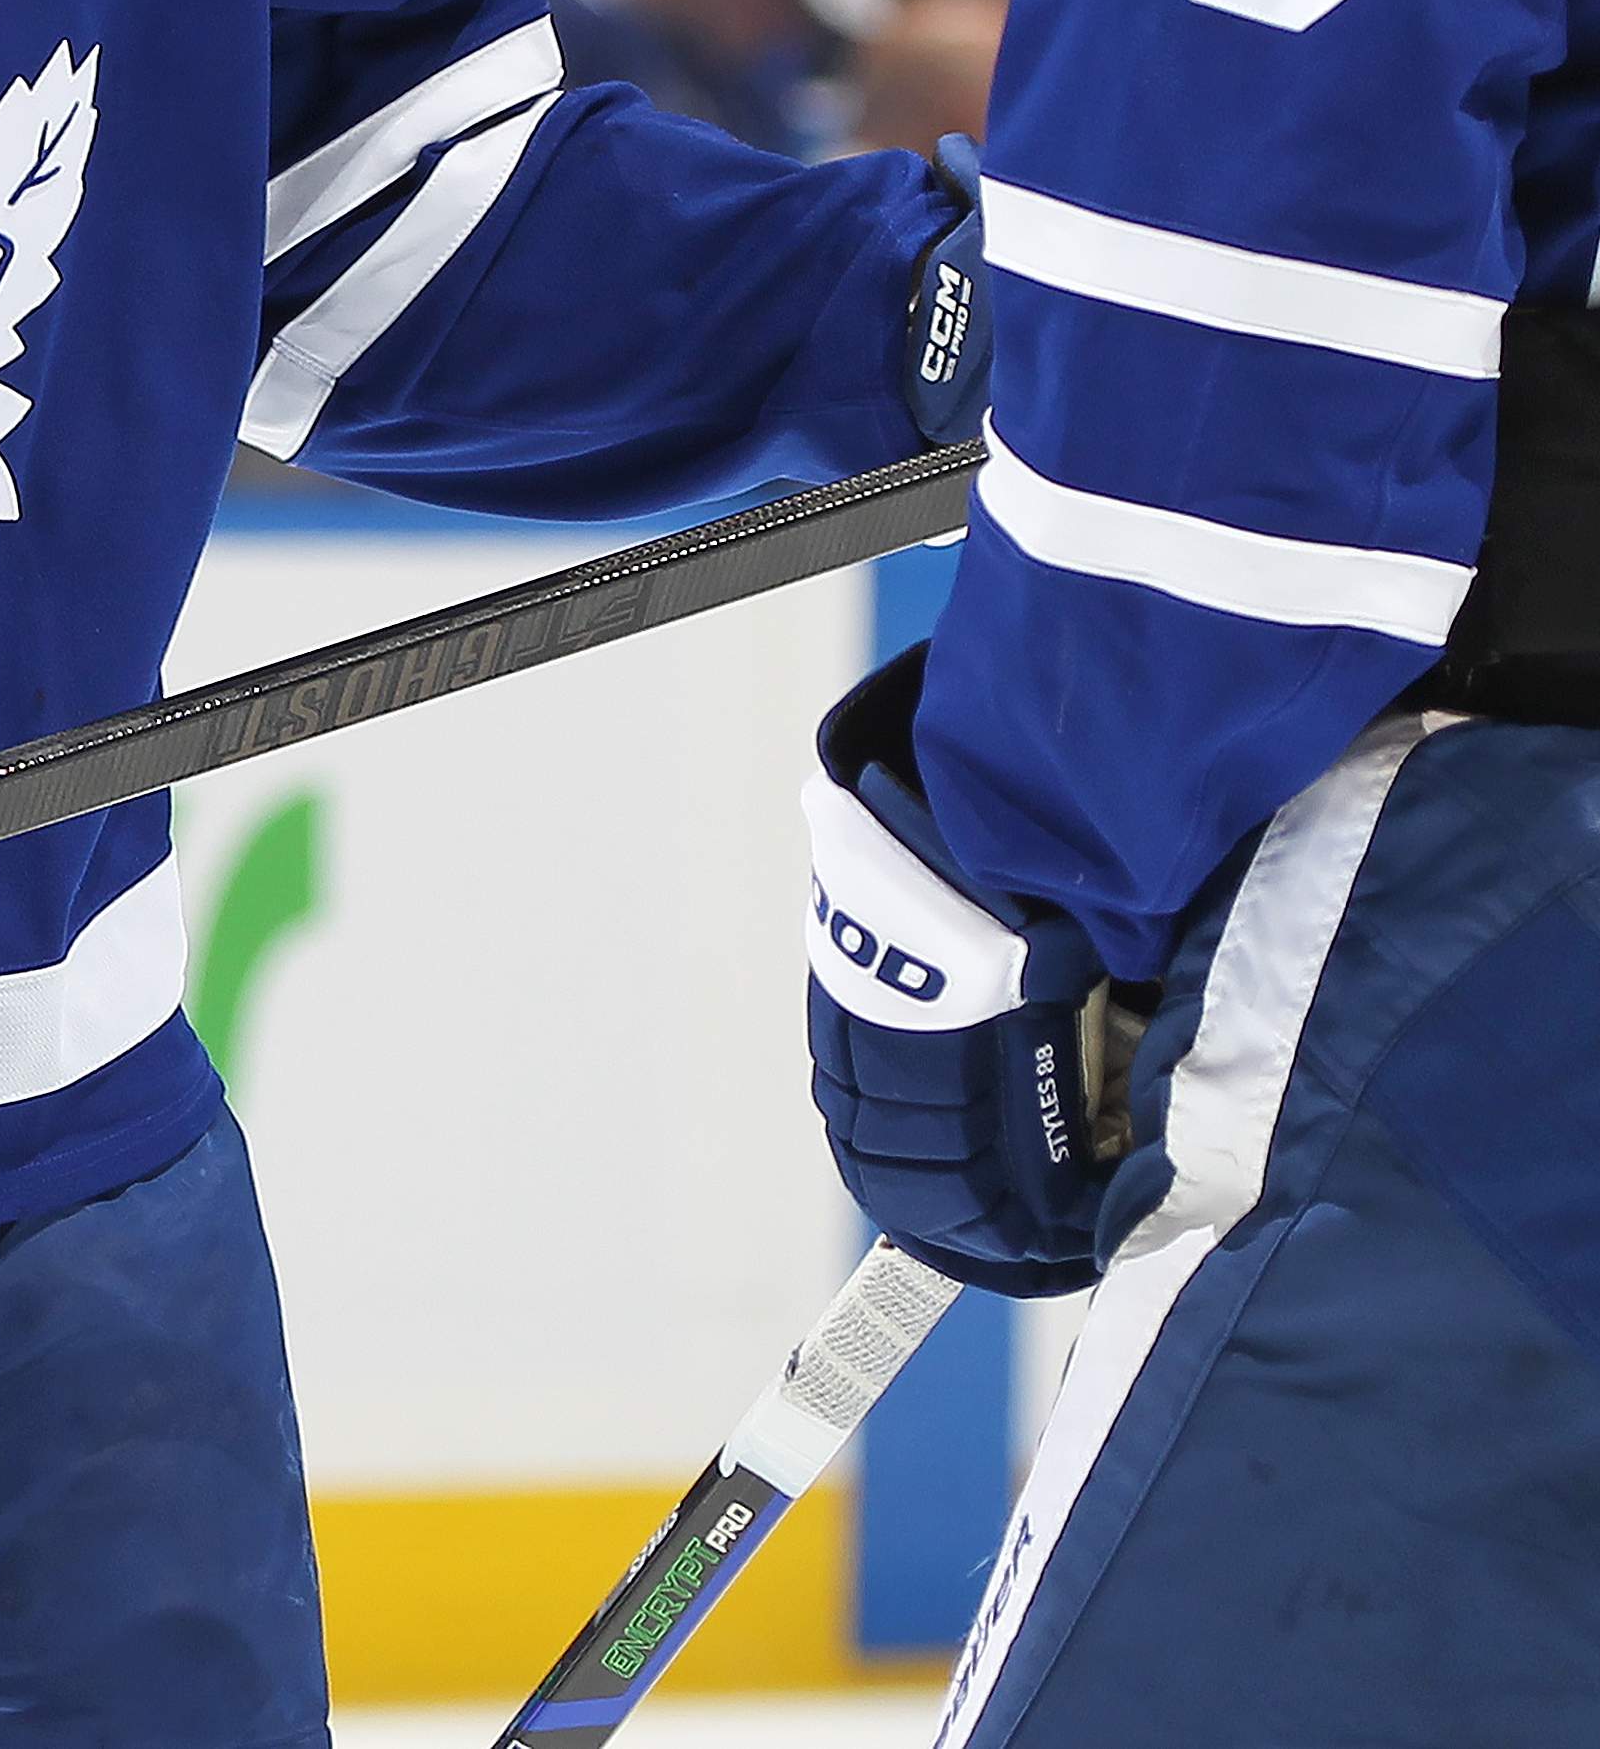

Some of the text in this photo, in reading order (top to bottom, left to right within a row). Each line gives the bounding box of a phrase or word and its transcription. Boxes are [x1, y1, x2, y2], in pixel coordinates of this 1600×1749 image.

[919, 261, 962, 383] CCM
[949, 305, 970, 356] PRO
[222, 621, 504, 764] GHOST
[1034, 1042, 1071, 1164] STYLES 88
[601, 1536, 721, 1681] ENCRYPT
[704, 1501, 756, 1554] PRO
